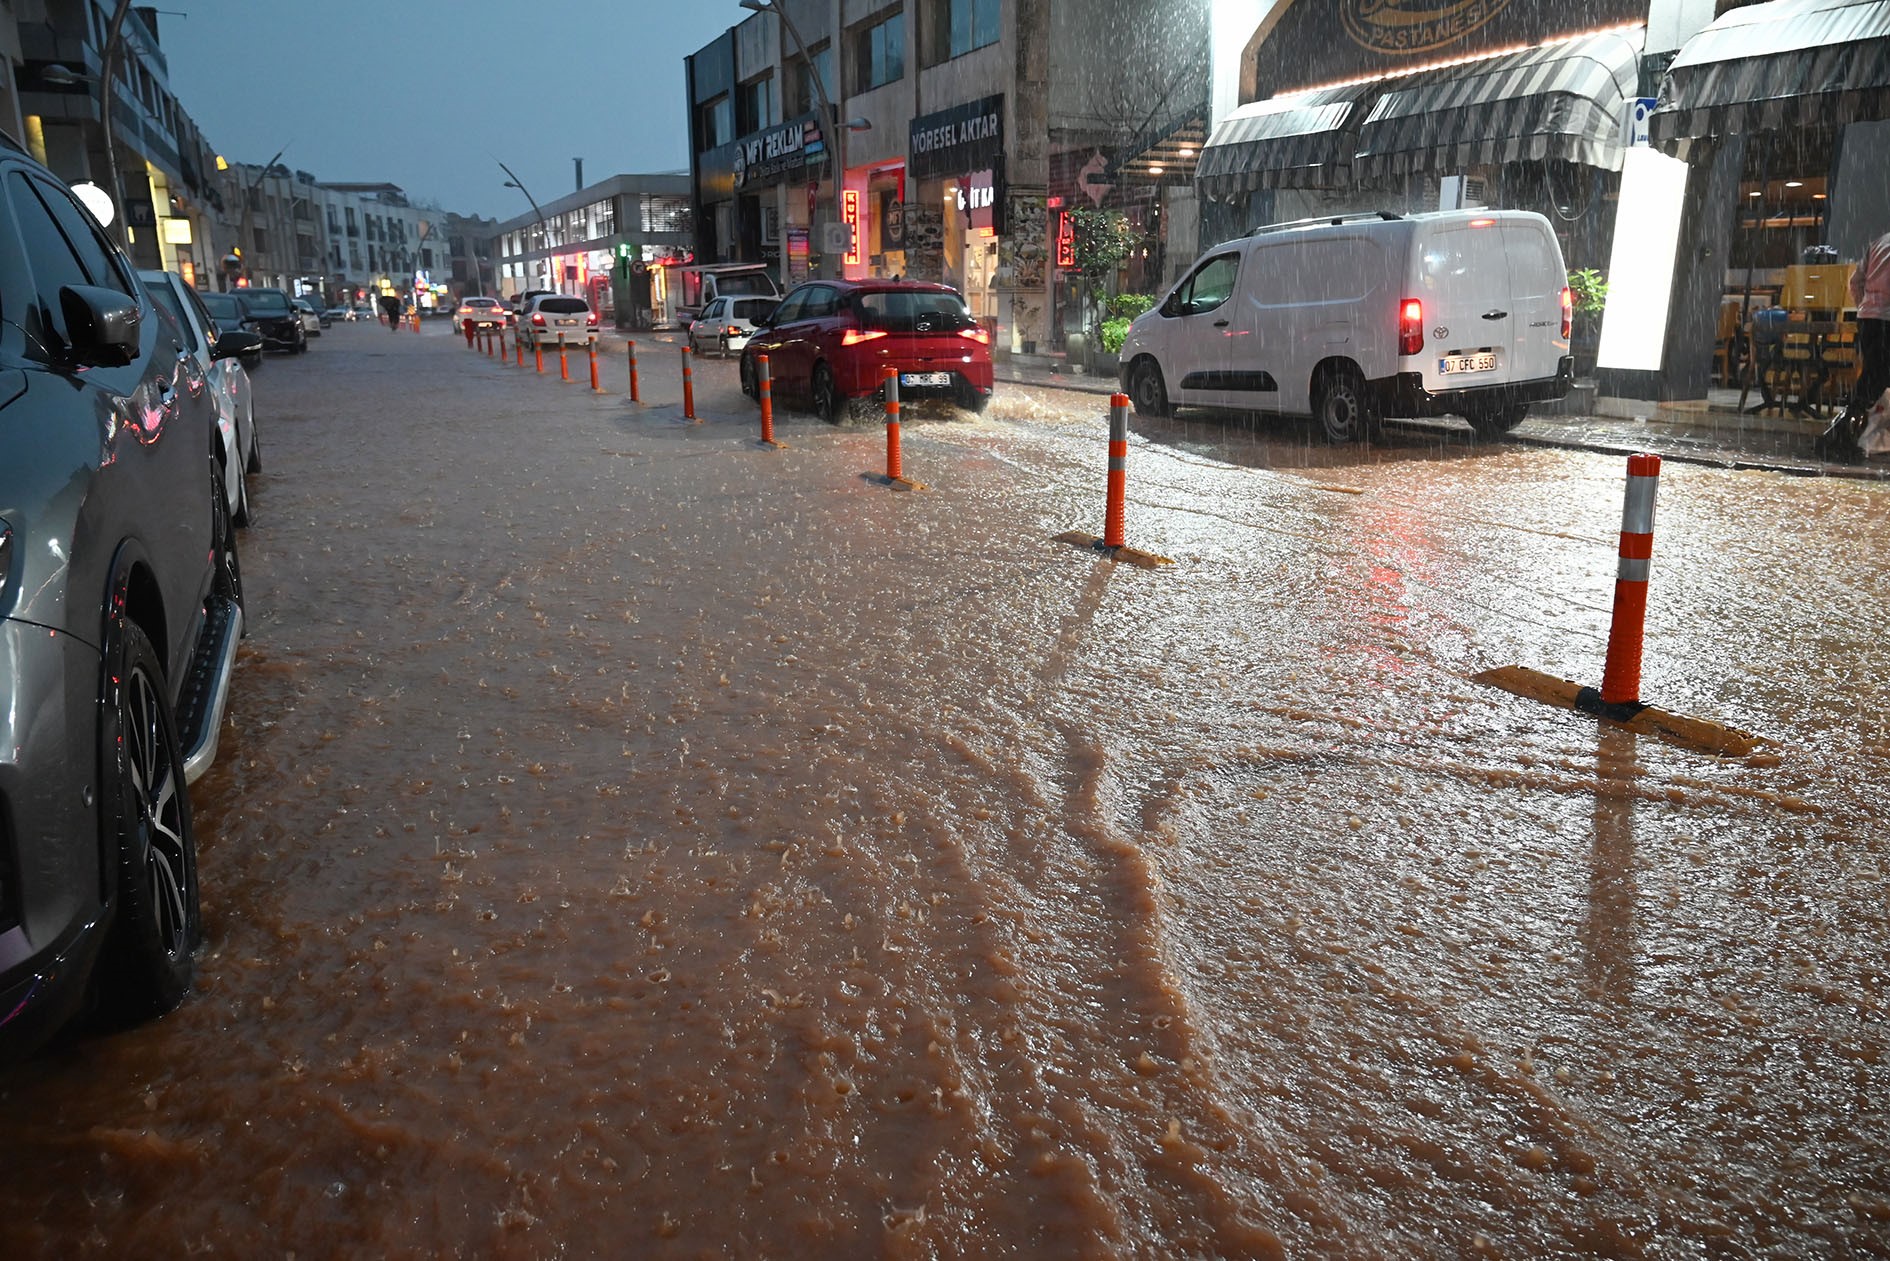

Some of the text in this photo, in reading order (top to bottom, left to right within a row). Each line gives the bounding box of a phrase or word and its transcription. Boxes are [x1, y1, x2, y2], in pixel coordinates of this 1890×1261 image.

[766, 123, 804, 159] REKLAM
[912, 113, 998, 154] YÖRESEL AKTAR
[1445, 357, 1494, 372] 07 CFC 550
